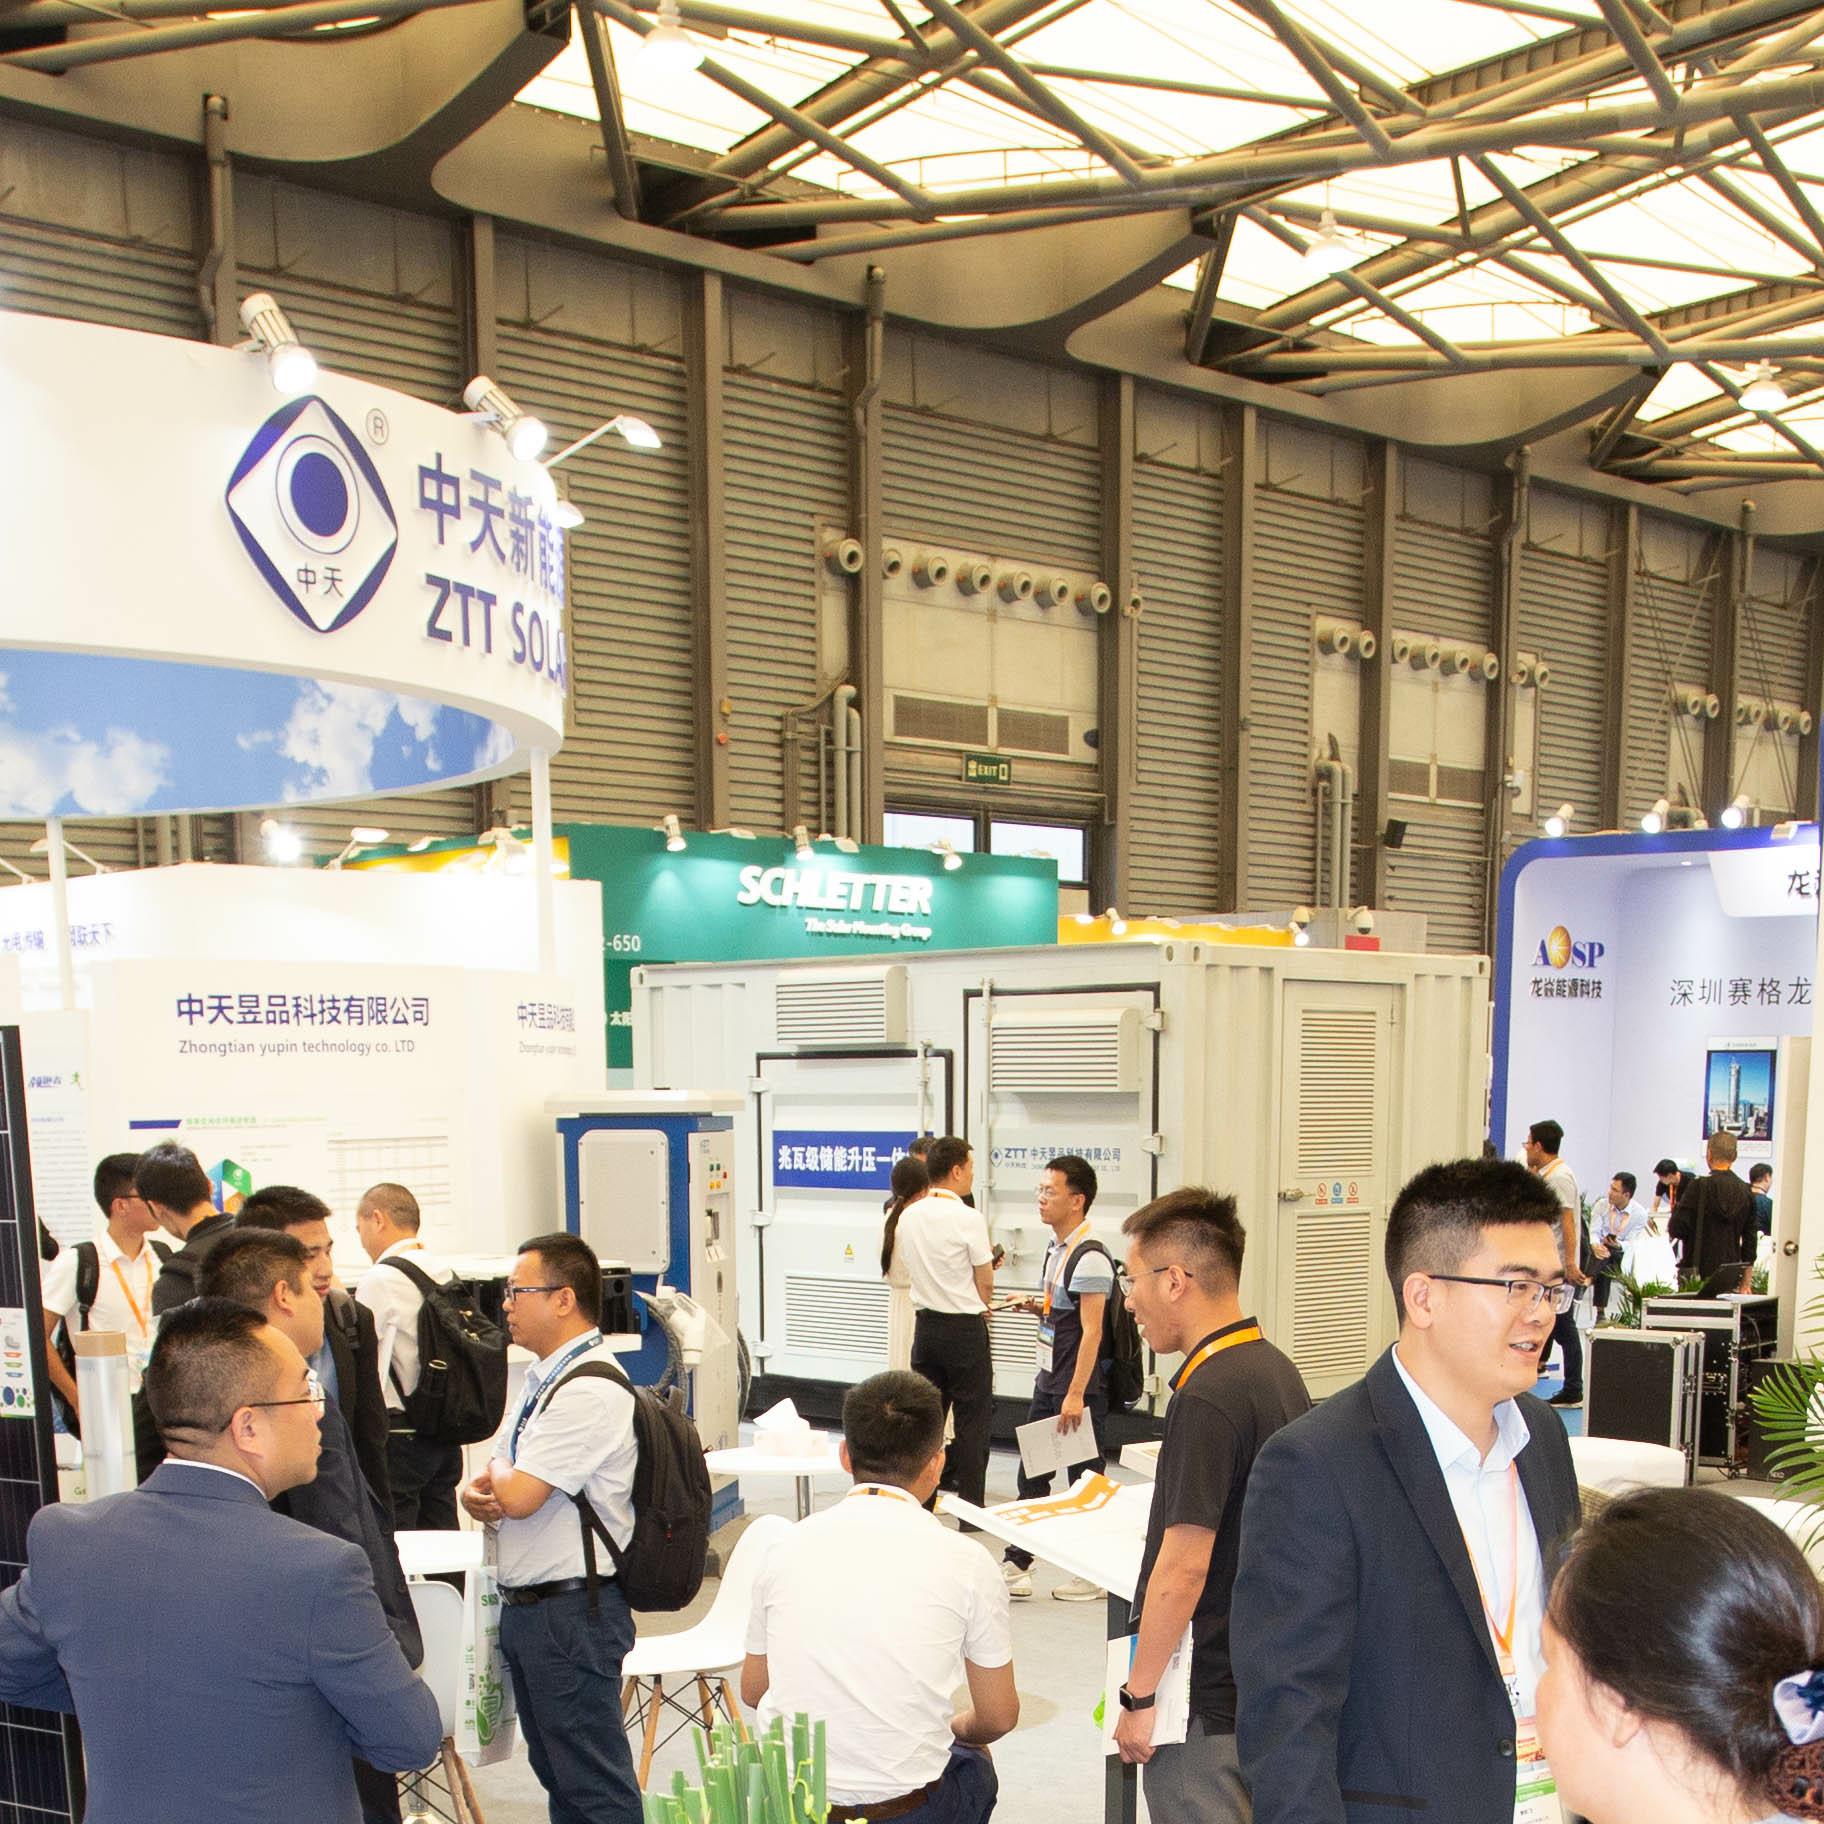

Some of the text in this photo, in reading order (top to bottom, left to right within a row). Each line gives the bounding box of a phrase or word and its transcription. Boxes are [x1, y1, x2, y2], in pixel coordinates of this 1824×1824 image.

[296, 561, 344, 598] 中天
[425, 572, 566, 694] ZTT SOLA
[736, 864, 933, 916] SCHLETTER
[603, 934, 641, 952] -650
[177, 992, 430, 1027] 中天昱品科技有限公司
[179, 1039, 255, 1057] Zhongtian
[259, 1039, 298, 1057] yupin
[302, 1038, 371, 1057] technology
[394, 1039, 416, 1053] LTD
[1004, 1148, 1028, 1159] ZTT
